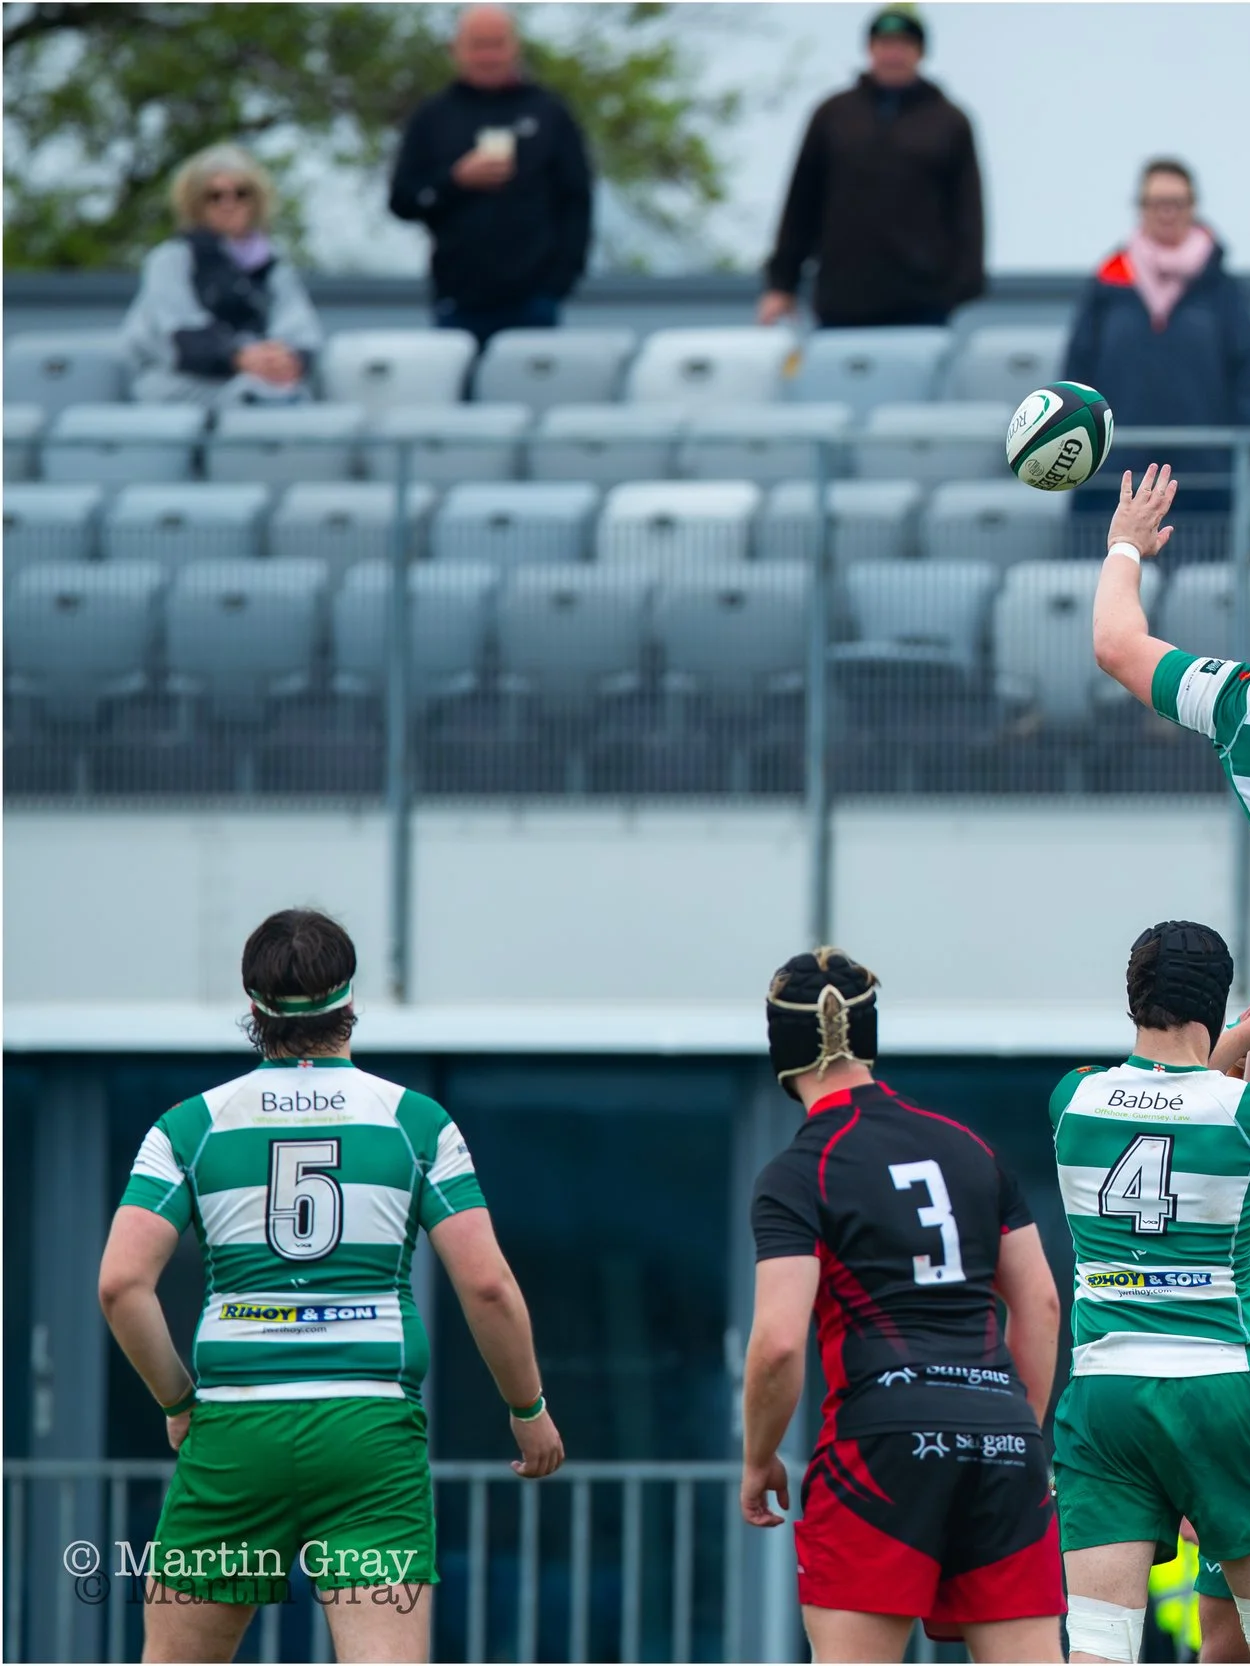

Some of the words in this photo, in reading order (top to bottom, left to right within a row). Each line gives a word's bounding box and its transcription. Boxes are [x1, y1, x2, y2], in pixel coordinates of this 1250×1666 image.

[261, 1090, 346, 1112] Babbé
[1107, 1089, 1184, 1111] Babbé
[1098, 1133, 1178, 1236] 4
[267, 1137, 343, 1263] 5
[888, 1159, 967, 1286] 3
[1149, 1275, 1162, 1285] &
[1165, 1273, 1208, 1286] SON
[224, 1305, 295, 1320] RIHOY
[302, 1307, 319, 1321] &
[324, 1307, 373, 1320] SON
